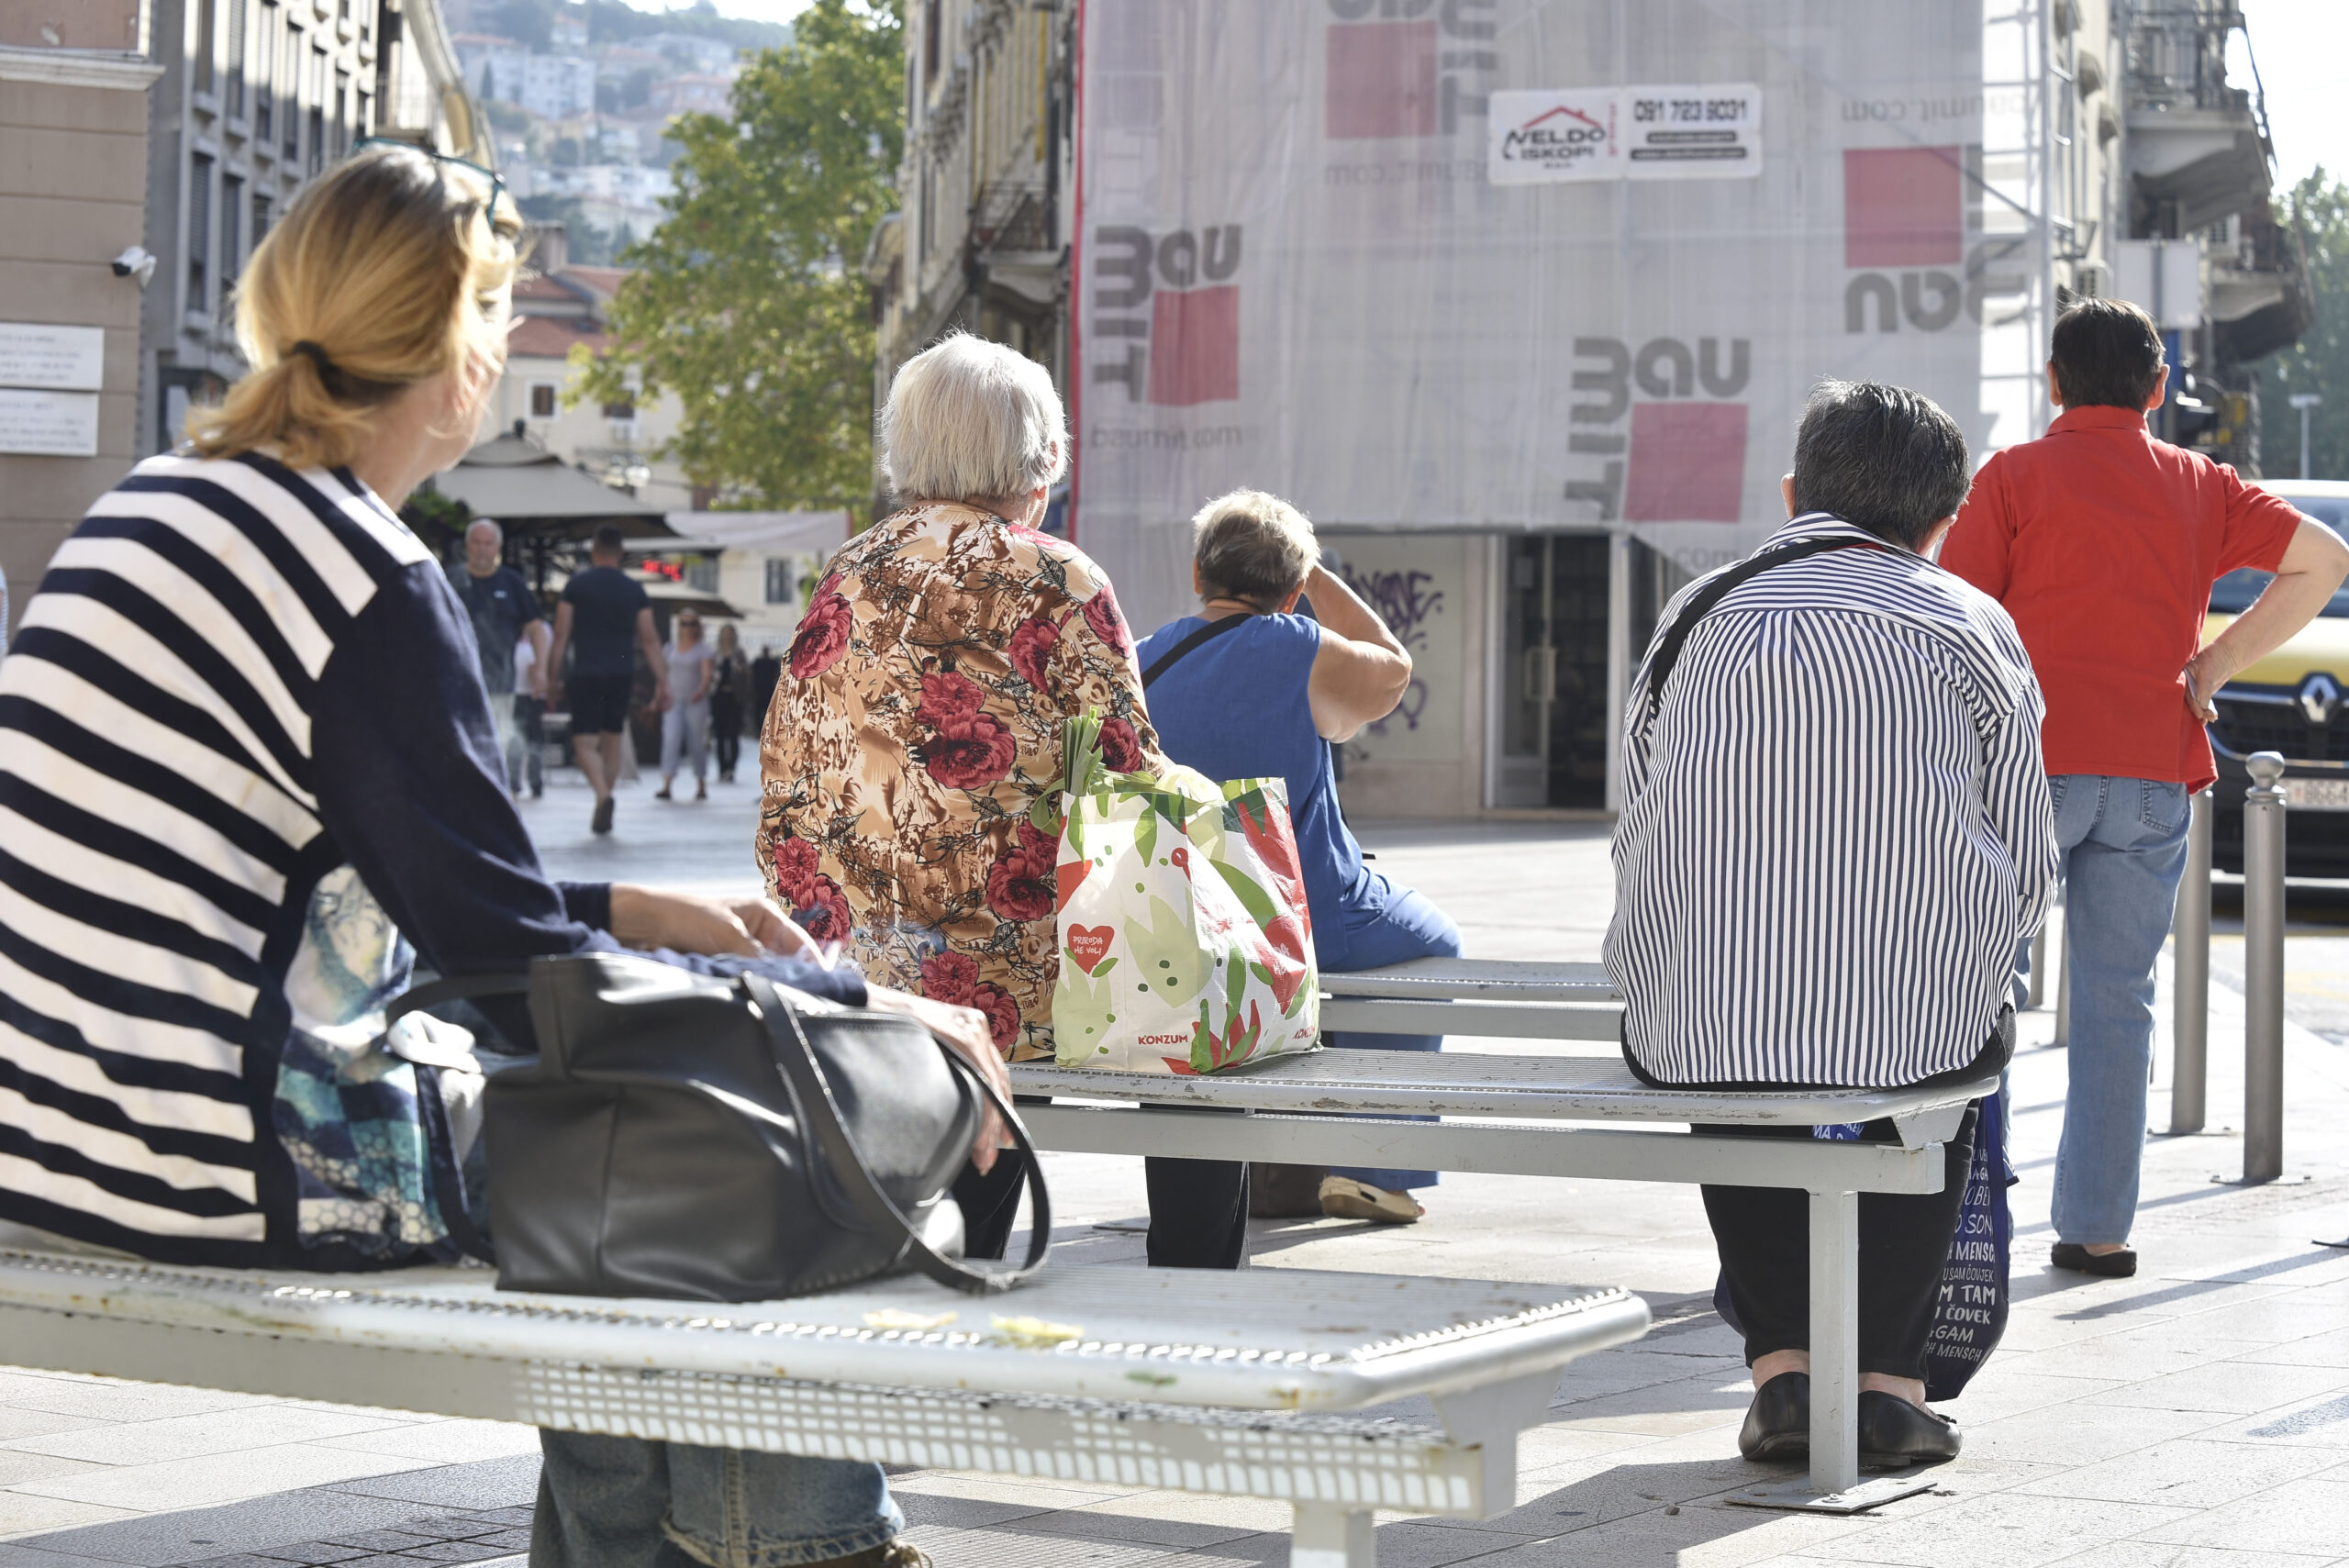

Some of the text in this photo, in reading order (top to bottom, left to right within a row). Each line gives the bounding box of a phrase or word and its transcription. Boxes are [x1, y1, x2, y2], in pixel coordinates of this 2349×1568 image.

[1634, 100, 1664, 121] 091
[1671, 100, 1701, 121] 723
[1507, 127, 1606, 145] VELDO
[1520, 147, 1595, 160] ISKOPI
[1072, 935, 1103, 946] PRIRODA
[1138, 1034, 1188, 1045] KONZUM
[1961, 1284, 1996, 1307] TAM
[1945, 1304, 1991, 1325] ČOVEK
[1937, 1343, 1983, 1363] MENSCH
